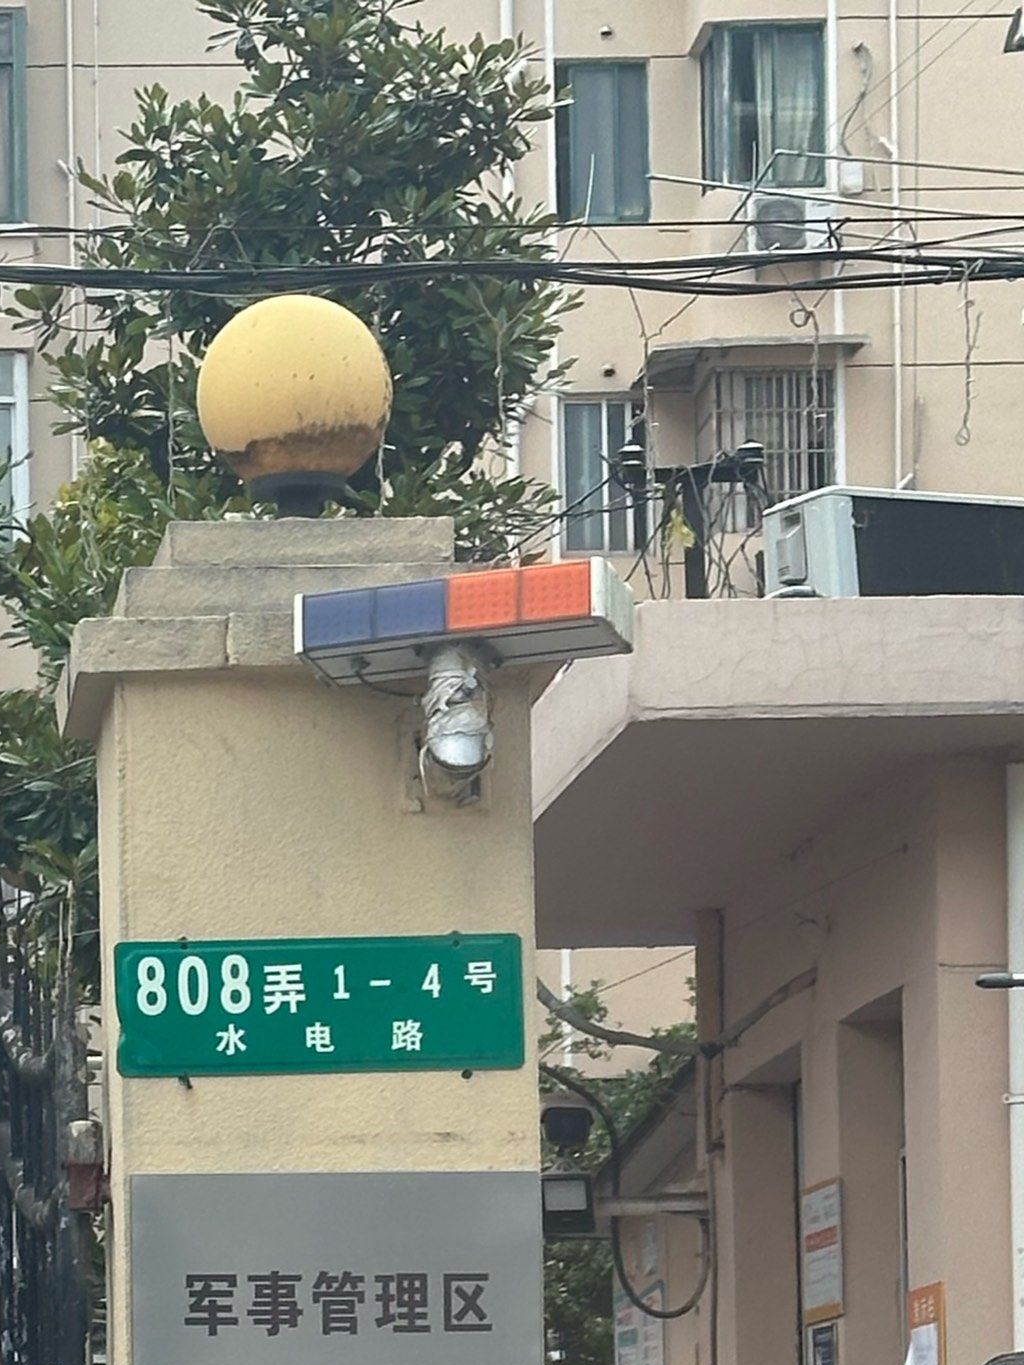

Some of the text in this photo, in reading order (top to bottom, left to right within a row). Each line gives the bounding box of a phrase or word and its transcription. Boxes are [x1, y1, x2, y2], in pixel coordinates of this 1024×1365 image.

[215, 1018, 424, 1056] 水电路
[184, 1270, 493, 1337] 军事管理区
